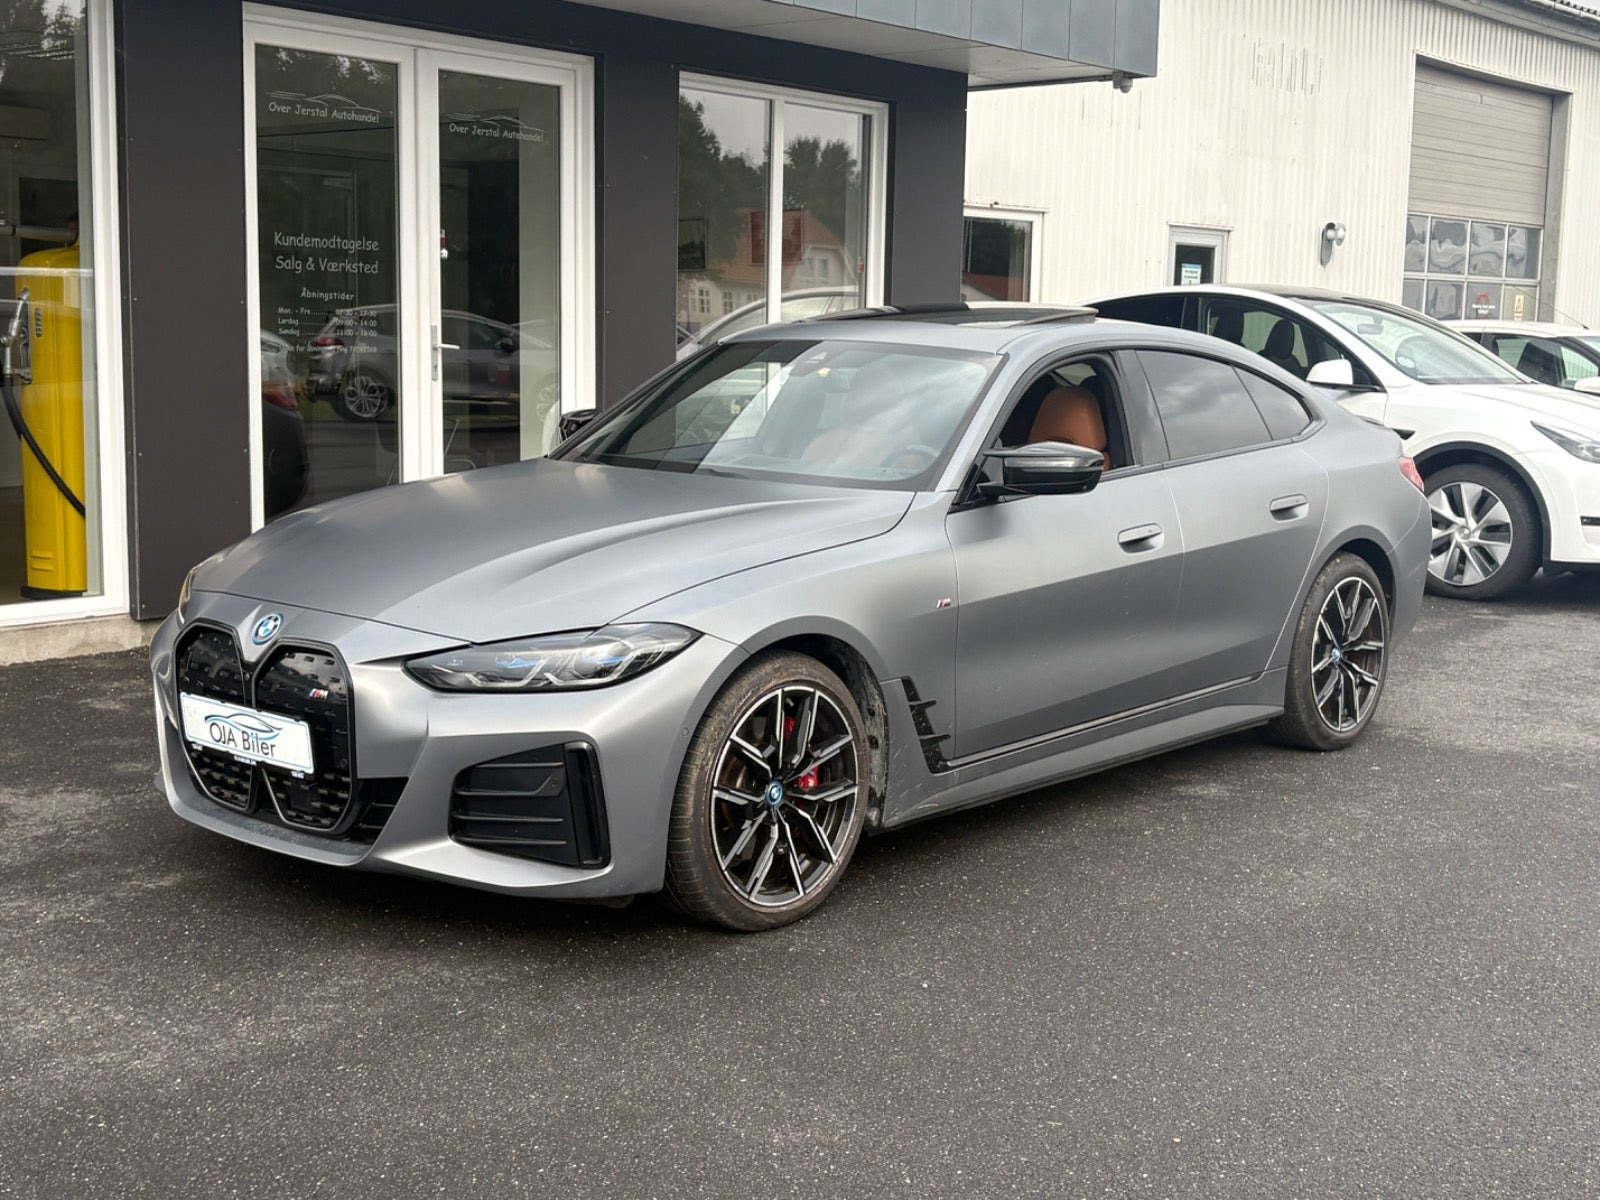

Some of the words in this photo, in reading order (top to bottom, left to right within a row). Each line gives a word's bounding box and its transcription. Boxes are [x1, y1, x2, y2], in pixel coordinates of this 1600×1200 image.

[268, 101, 291, 113] Over
[295, 104, 328, 117] Jerstal
[332, 109, 380, 123] Autohandel
[448, 122, 469, 134] Over
[471, 125, 500, 137] Jerstal
[502, 129, 544, 142] Autohandel
[274, 231, 379, 253] Kundemodtagelse
[275, 255, 303, 274] Salg
[305, 256, 316, 271] &
[318, 257, 379, 274] Værksted
[300, 287, 355, 301] Åbningstider
[209, 721, 238, 748] OJA
[242, 731, 276, 757] Biler
